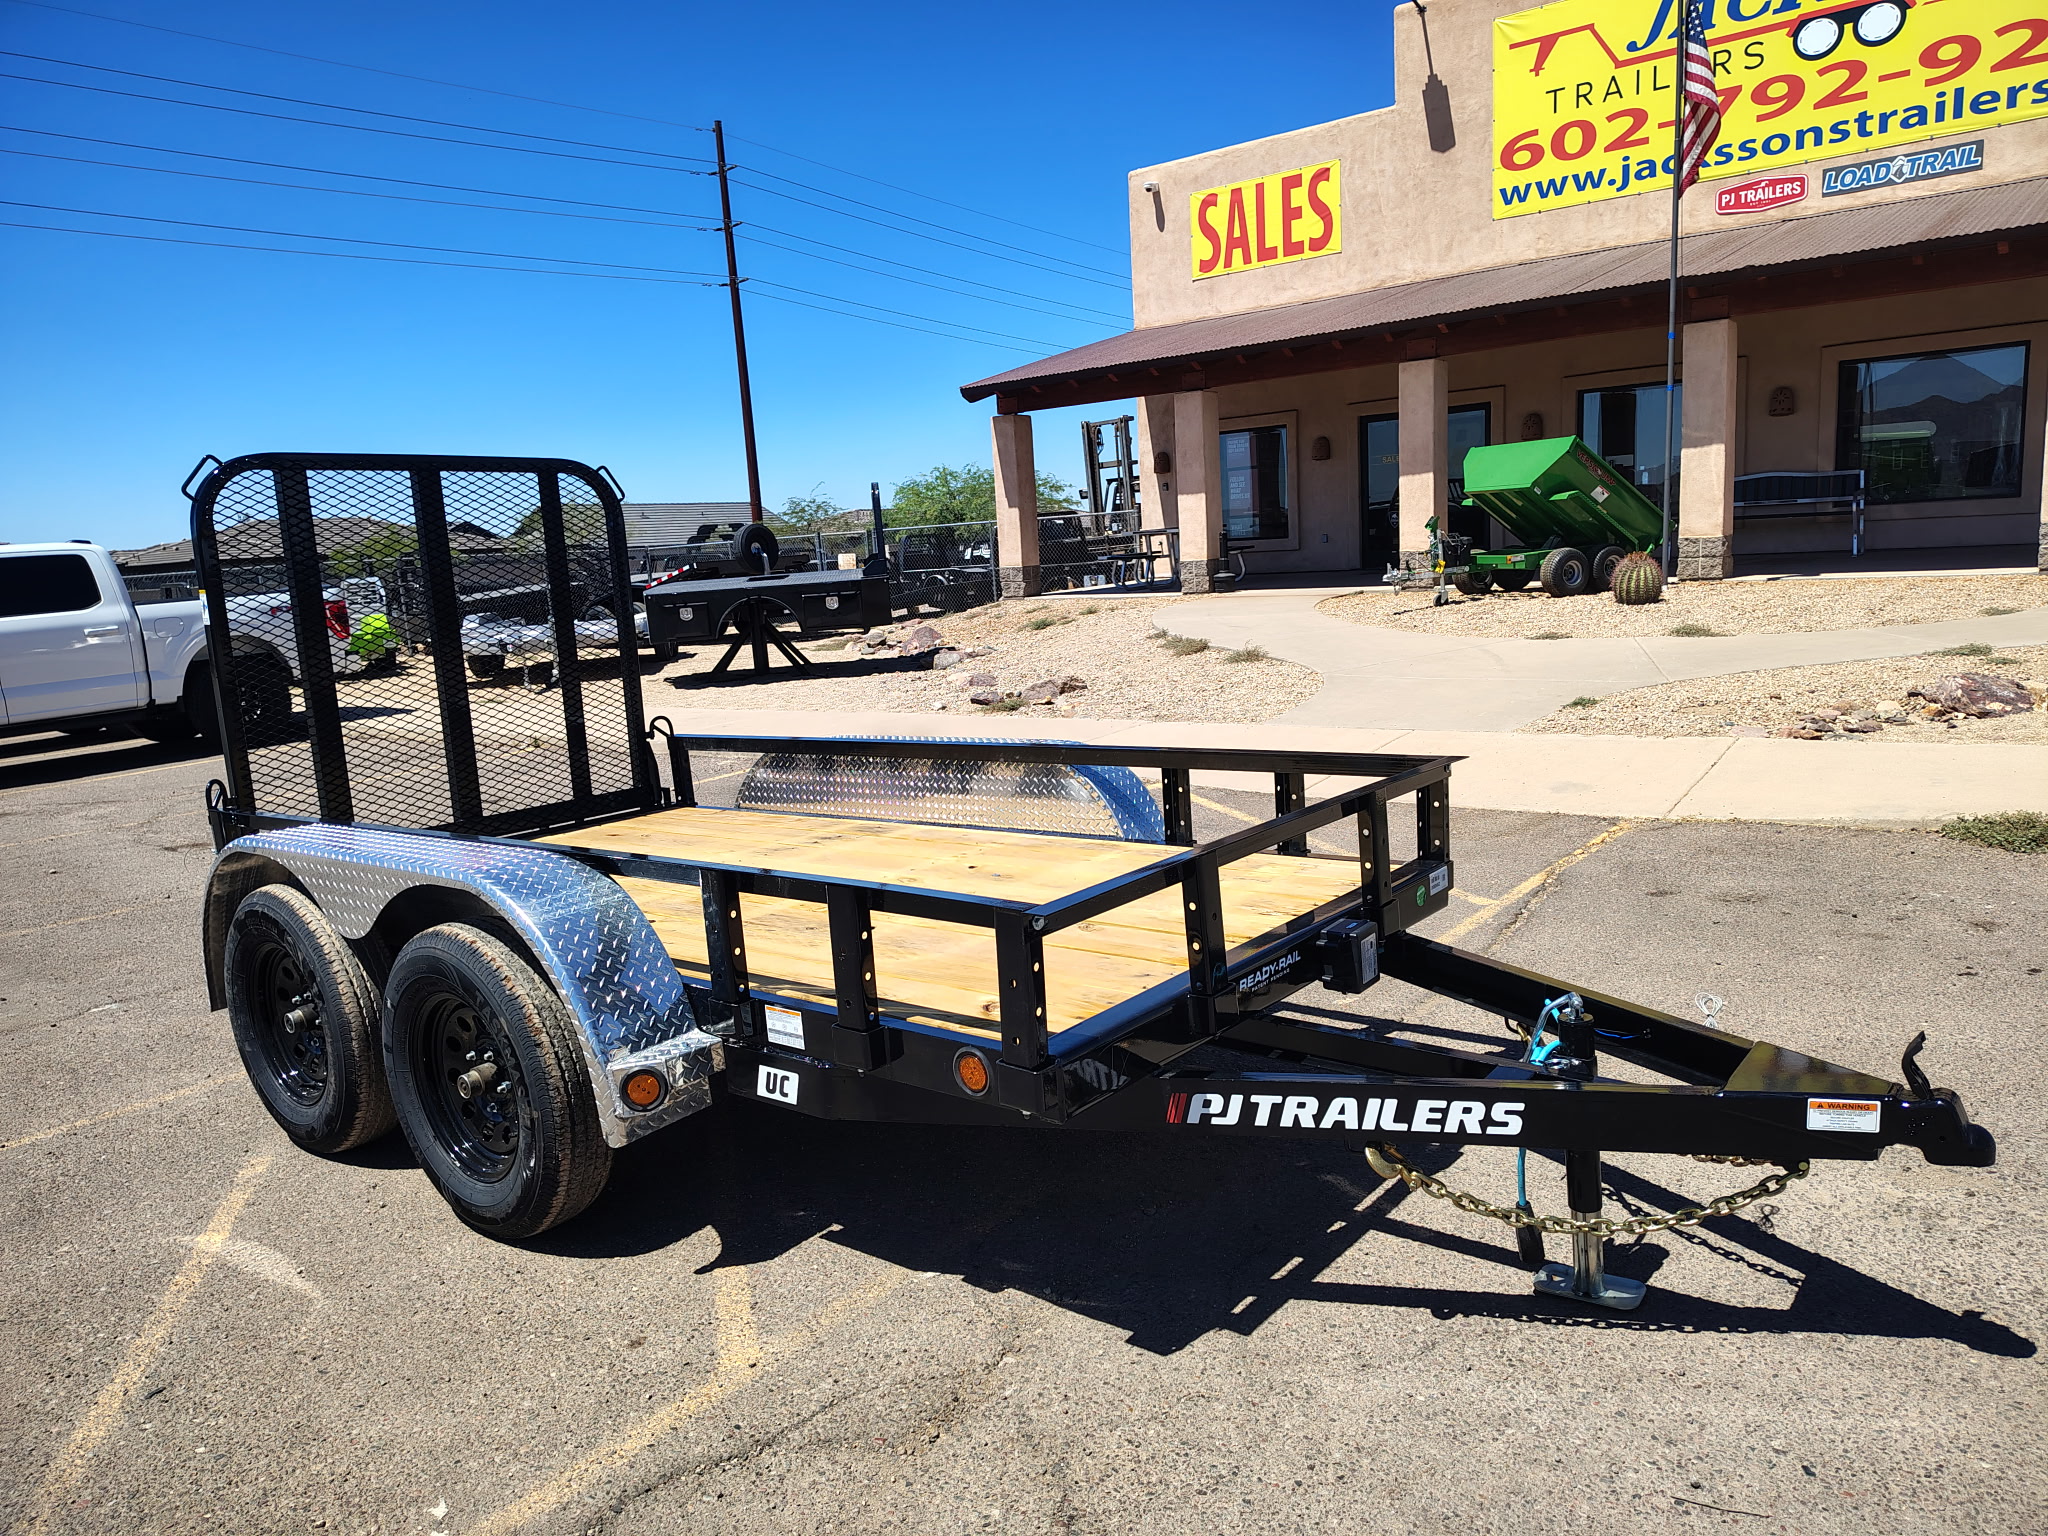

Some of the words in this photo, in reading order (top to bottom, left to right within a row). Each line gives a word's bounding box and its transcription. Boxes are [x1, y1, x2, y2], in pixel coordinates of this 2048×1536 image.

[1545, 41, 1766, 114] TRAILRS
[1498, 78, 2048, 206] www.jacssonstrailers
[1823, 161, 1893, 193] LOAD
[1904, 144, 1983, 178] TRAIL
[1721, 192, 1736, 207] PJ
[1739, 181, 1802, 204] TRAILERS
[1198, 167, 1334, 274] SALES
[765, 1071, 790, 1098] UC
[1827, 1102, 1871, 1111] WARNING
[1186, 1093, 1244, 1126] PJ
[1248, 1094, 1526, 1136] TRAILERS
